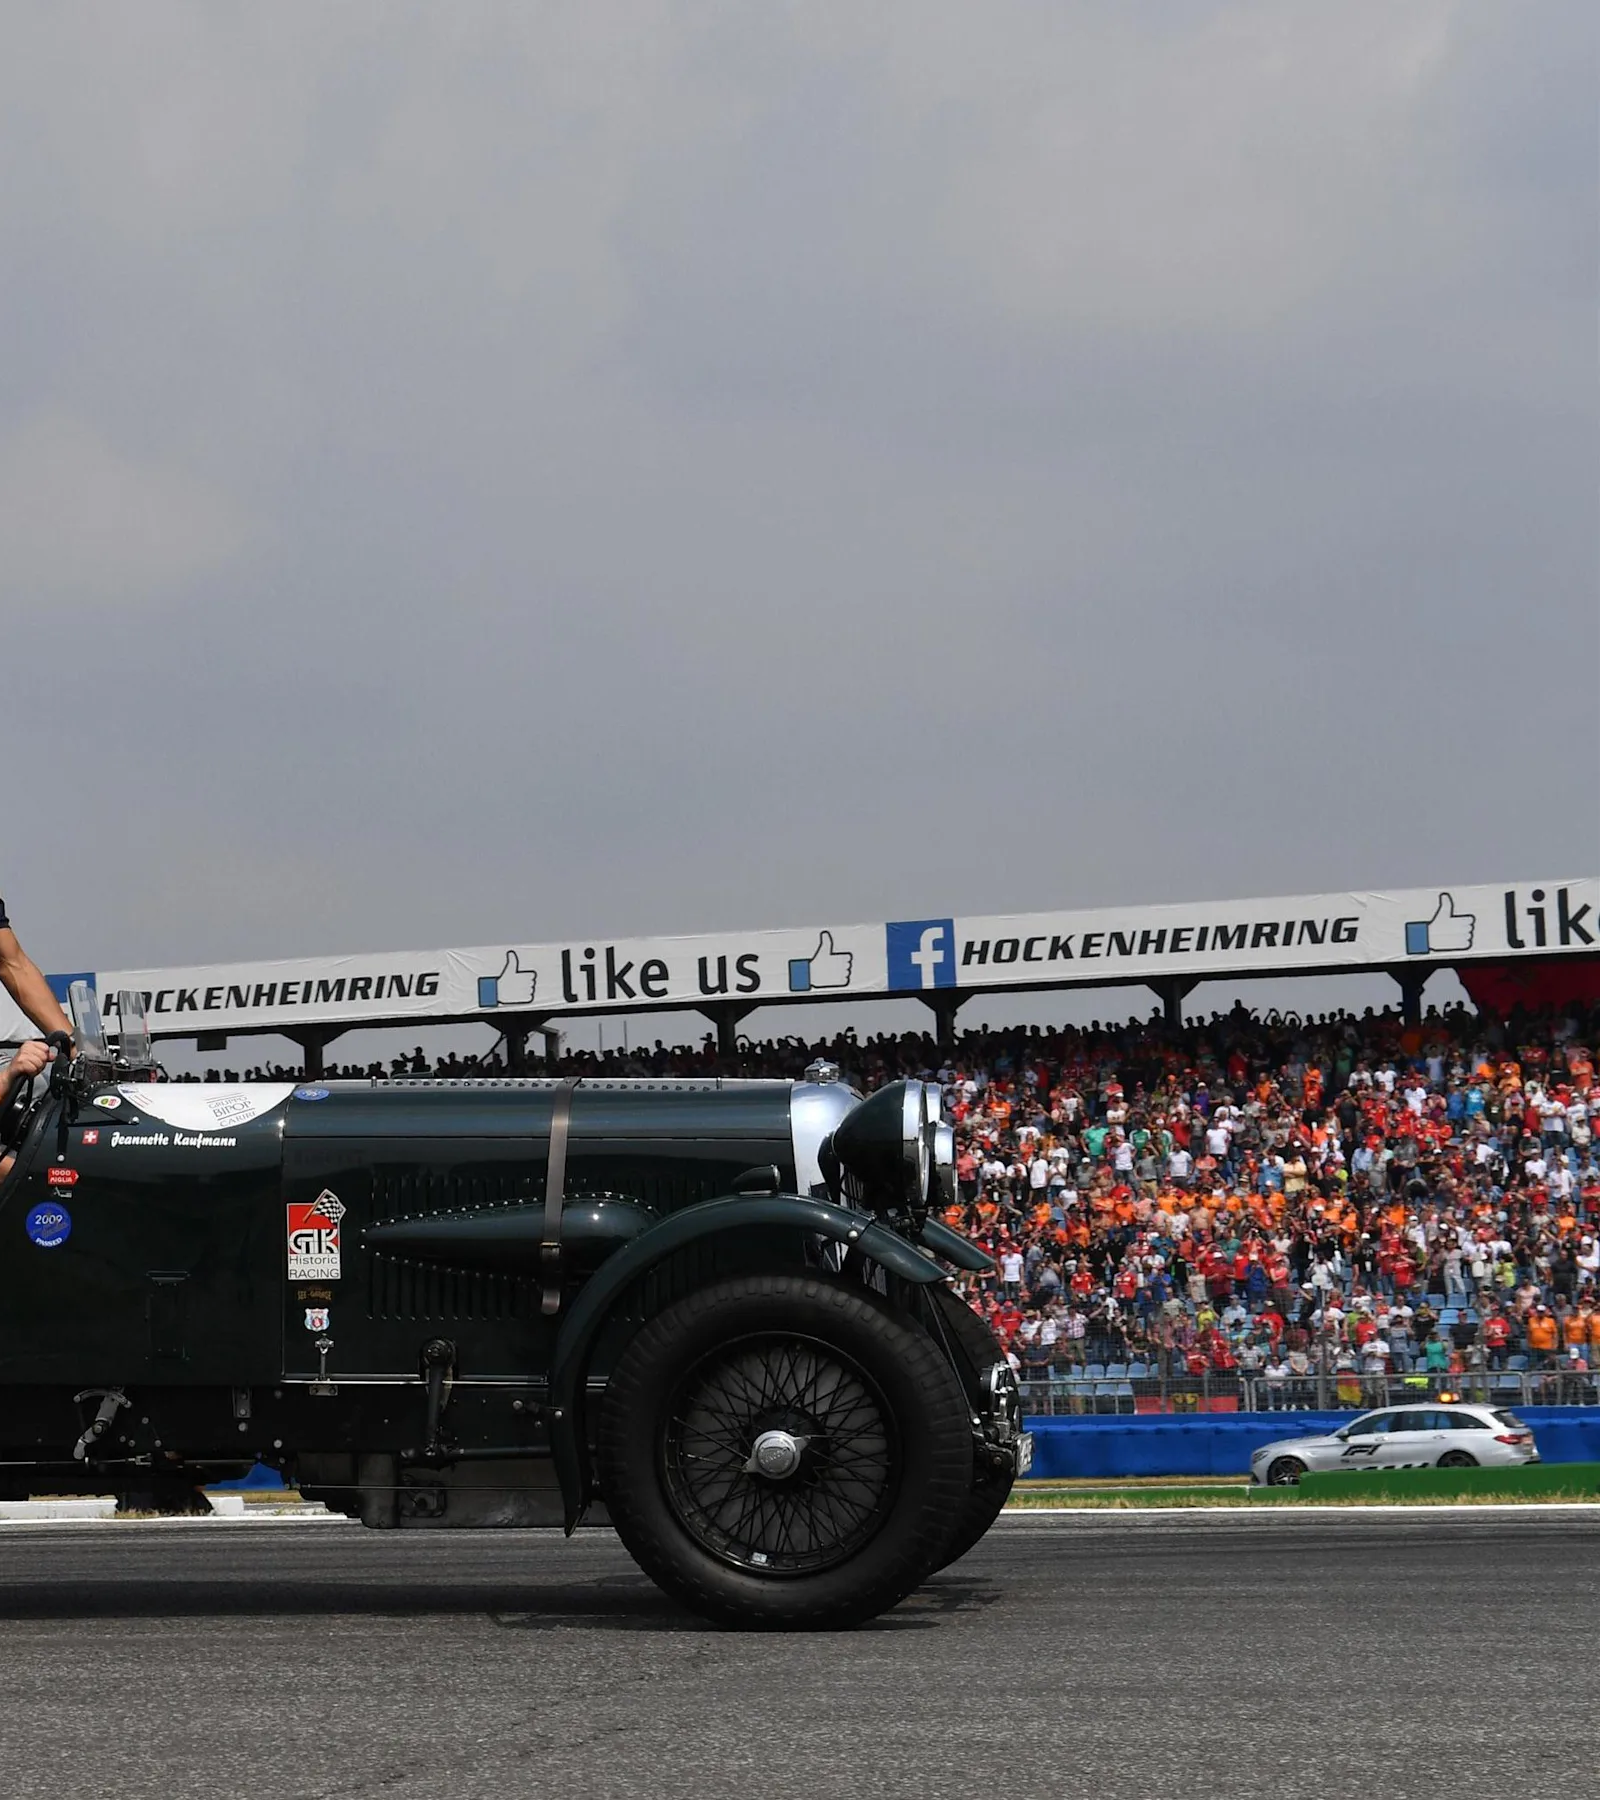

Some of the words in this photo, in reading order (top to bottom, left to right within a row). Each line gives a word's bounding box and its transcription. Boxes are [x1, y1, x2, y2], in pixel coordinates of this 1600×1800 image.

[1505, 887, 1600, 949] lik
[962, 917, 1360, 966] HOCKENHEIMRING
[561, 946, 670, 1003] like
[698, 953, 761, 995] us
[212, 1100, 251, 1118] BIPOP
[111, 1131, 168, 1148] Jeannette
[173, 1132, 237, 1148] Kaufmann
[35, 1214, 63, 1225] 2009
[289, 1255, 338, 1265] Historic
[289, 1268, 340, 1279] RACING
